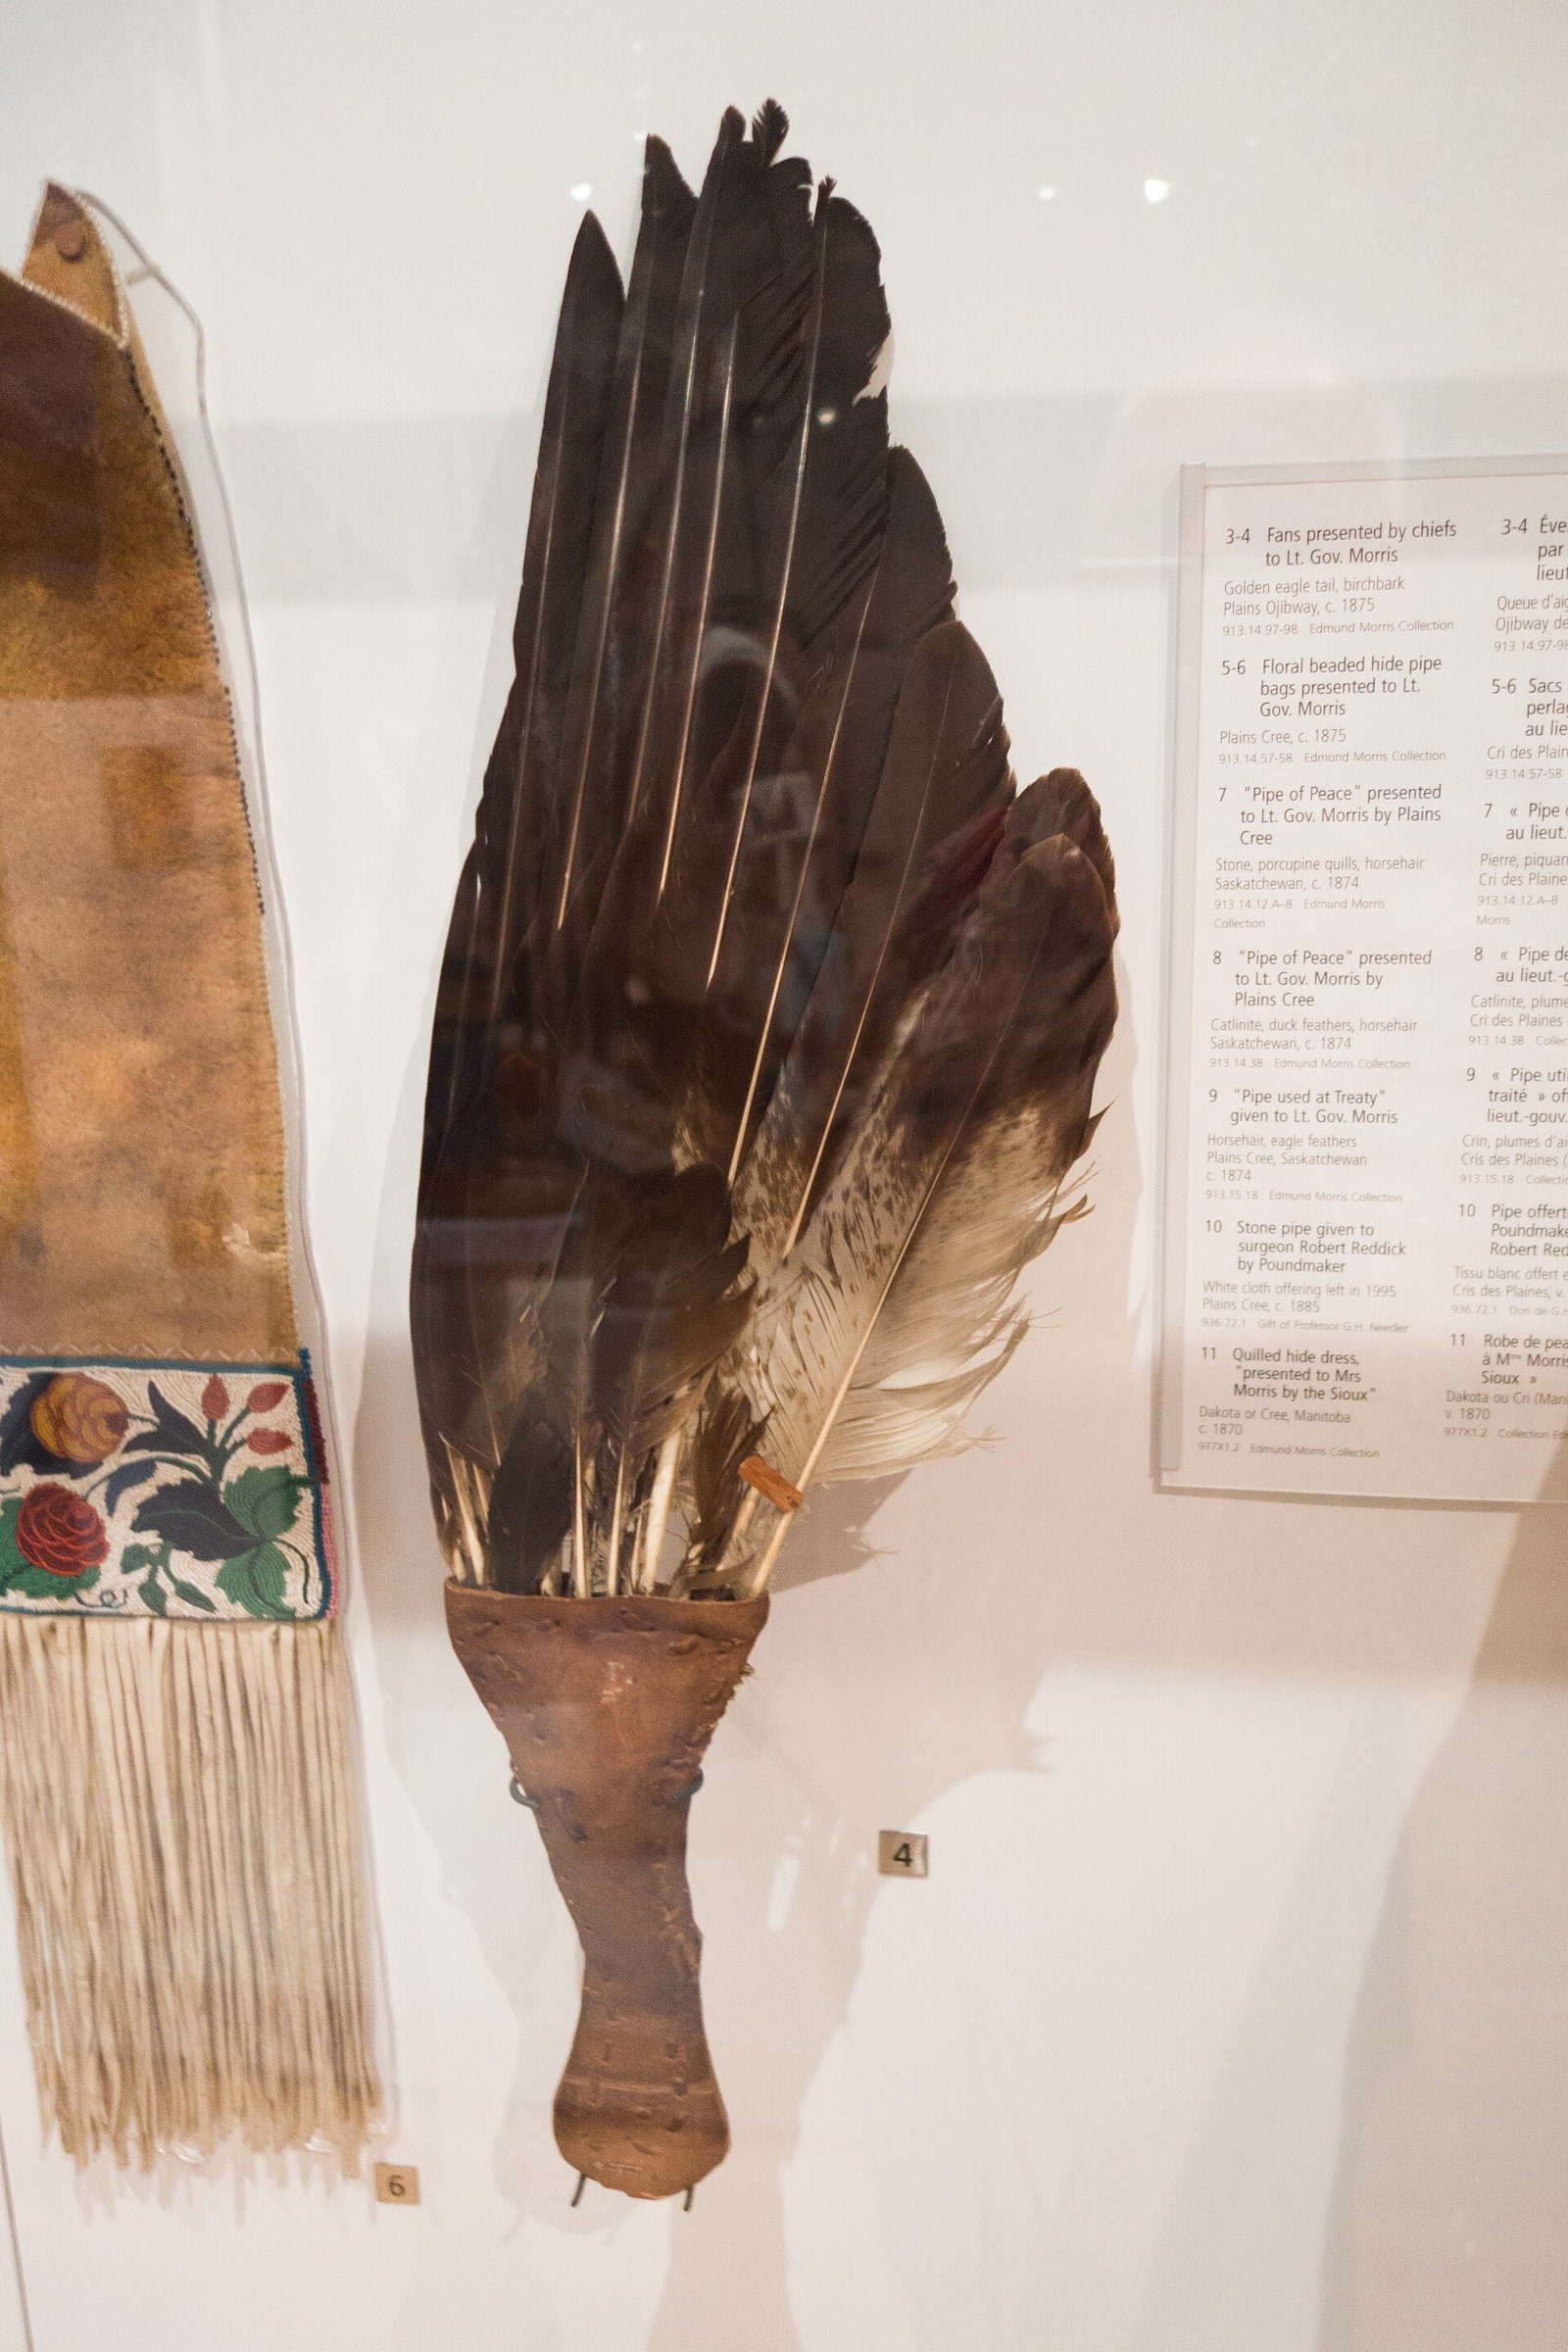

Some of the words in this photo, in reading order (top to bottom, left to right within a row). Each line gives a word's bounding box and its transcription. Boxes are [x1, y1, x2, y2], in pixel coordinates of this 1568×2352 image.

[1226, 528, 1250, 544] 3-4
[1267, 527, 1300, 543] Fans
[1306, 523, 1383, 545] presented
[1389, 523, 1406, 541] by
[1412, 520, 1456, 537] chiefs
[1502, 518, 1527, 534] 3-4
[1266, 553, 1280, 565] to
[1287, 551, 1303, 564] Lt.
[1310, 548, 1343, 564] Gov.
[1349, 547, 1398, 563] Morris
[1539, 544, 1563, 562] par
[1225, 580, 1270, 595] Golden
[1276, 578, 1309, 596] eagle
[1315, 578, 1338, 593] tail,
[1344, 575, 1404, 591] birchbark
[1224, 601, 1261, 615] Plains
[1266, 600, 1320, 617] Ojibway,
[1326, 602, 1335, 612] c.
[1343, 598, 1374, 612] 1875
[1497, 596, 1538, 612] Queue
[1223, 624, 1298, 636] 913.14.97-98
[1310, 623, 1354, 634] Edmund
[1359, 622, 1395, 632] Morris
[1398, 621, 1453, 631] Collection
[1496, 617, 1548, 634] Ojibway
[1222, 661, 1246, 675] 5-6
[1262, 659, 1302, 674] Floral
[1309, 658, 1364, 673] beaded
[1371, 656, 1403, 671] hide
[1409, 656, 1442, 674] pipe
[1260, 681, 1296, 699] bags
[1301, 678, 1375, 697] presented
[1382, 680, 1396, 692] to
[1402, 678, 1420, 692] Lt.
[1492, 679, 1516, 694] 5-6
[1529, 678, 1561, 693] Sacs
[1260, 703, 1292, 716] Gov.
[1298, 701, 1346, 715] Morris
[1220, 731, 1256, 744] Plains
[1261, 730, 1293, 745] Cree,
[1298, 733, 1307, 743] c.
[1314, 729, 1347, 742] 1875
[1526, 724, 1544, 736] au
[1488, 746, 1505, 760] Cri
[1510, 745, 1532, 759] des
[1218, 788, 1227, 803] 7
[1290, 786, 1303, 801] of
[1367, 784, 1442, 804] presented
[1241, 810, 1254, 823] to
[1261, 809, 1278, 823] Lt.
[1284, 808, 1315, 822] Gov.
[1321, 808, 1368, 822] Morris
[1374, 807, 1392, 825] by
[1397, 807, 1441, 821] Plains
[1484, 804, 1492, 818] 7
[1529, 803, 1560, 820] Pipe
[1241, 830, 1272, 845] Cree
[1506, 829, 1524, 840] au
[1216, 858, 1253, 872] Stone,
[1258, 858, 1320, 873] porcupine
[1325, 858, 1360, 872] quills,
[1365, 857, 1425, 870] horsehair
[1215, 878, 1306, 892] Saskatchewan,
[1312, 880, 1321, 890] c.
[1328, 876, 1359, 889] 1874
[1213, 951, 1221, 964] 8
[1283, 951, 1298, 964] of
[1359, 950, 1432, 967] presented
[1474, 947, 1483, 961] 8
[1519, 947, 1548, 964] Pipe
[1236, 973, 1249, 985] to
[1255, 972, 1271, 985] Lt.
[1278, 971, 1308, 985] Gov.
[1314, 971, 1360, 985] Morris
[1366, 971, 1383, 989] by
[1496, 972, 1514, 983] au
[1235, 993, 1276, 1006] Plains
[1282, 993, 1314, 1005] Cree
[1471, 995, 1526, 1008] Catlinite,
[1211, 1018, 1264, 1032] Catlinite,
[1269, 1019, 1298, 1031] duck
[1302, 1019, 1354, 1033] feathers,
[1359, 1019, 1417, 1032] horsehair
[1210, 1037, 1299, 1051] Saskatchewan,
[1305, 1040, 1314, 1050] c.
[1321, 1037, 1350, 1050] 1874
[1467, 1068, 1475, 1081] 9
[1510, 1068, 1542, 1085] Pipe
[1209, 1089, 1217, 1102] 9
[1278, 1090, 1310, 1103] used
[1316, 1092, 1330, 1102] at
[1489, 1089, 1527, 1102] traité
[1231, 1108, 1268, 1125] given
[1274, 1110, 1288, 1122] to
[1294, 1109, 1310, 1122] Lt.
[1316, 1109, 1347, 1123] Gov.
[1352, 1109, 1397, 1123] Morris
[1207, 1135, 1266, 1148] Horsehair,
[1271, 1137, 1302, 1151] eagle
[1308, 1135, 1357, 1147] feathers
[1207, 1152, 1242, 1164] Plains
[1247, 1152, 1276, 1165] Cree,
[1281, 1152, 1367, 1165] Saskatchewan
[1206, 1171, 1214, 1181] c.
[1222, 1169, 1251, 1181] 1874
[1459, 1204, 1476, 1217] 10
[1492, 1204, 1522, 1221] Pipe
[1205, 1220, 1222, 1233] 10
[1238, 1221, 1276, 1234] Stone
[1282, 1223, 1311, 1238] pipe
[1316, 1223, 1354, 1239] given
[1360, 1224, 1375, 1236] to
[1239, 1242, 1293, 1255] surgeon
[1299, 1241, 1346, 1254] Robert
[1351, 1242, 1406, 1255] Reddick
[1491, 1243, 1538, 1256] Robert
[1238, 1257, 1253, 1273] by
[1259, 1258, 1347, 1272] Poundmaker
[1451, 1334, 1465, 1346] 11
[1484, 1334, 1518, 1348] Robe
[1524, 1335, 1541, 1348] de
[1202, 1348, 1216, 1359] 11
[1233, 1348, 1281, 1363] Quilled
[1287, 1349, 1316, 1363] hide
[1321, 1351, 1359, 1366] dress,
[1483, 1353, 1491, 1366] à
[1316, 1370, 1330, 1381] to
[1335, 1370, 1361, 1383] Mrs
[1482, 1371, 1519, 1385] Sioux
[1234, 1384, 1277, 1397] Morris
[1282, 1385, 1298, 1400] by
[1303, 1387, 1325, 1399] the
[1200, 1406, 1240, 1419] Dakota
[1245, 1409, 1256, 1419] or
[1261, 1408, 1290, 1422] Cree,
[1295, 1409, 1351, 1423] Manitoba
[1213, 1424, 1243, 1435] 1870
[894, 1842, 913, 1867] 4
[388, 2175, 406, 2196] 6
